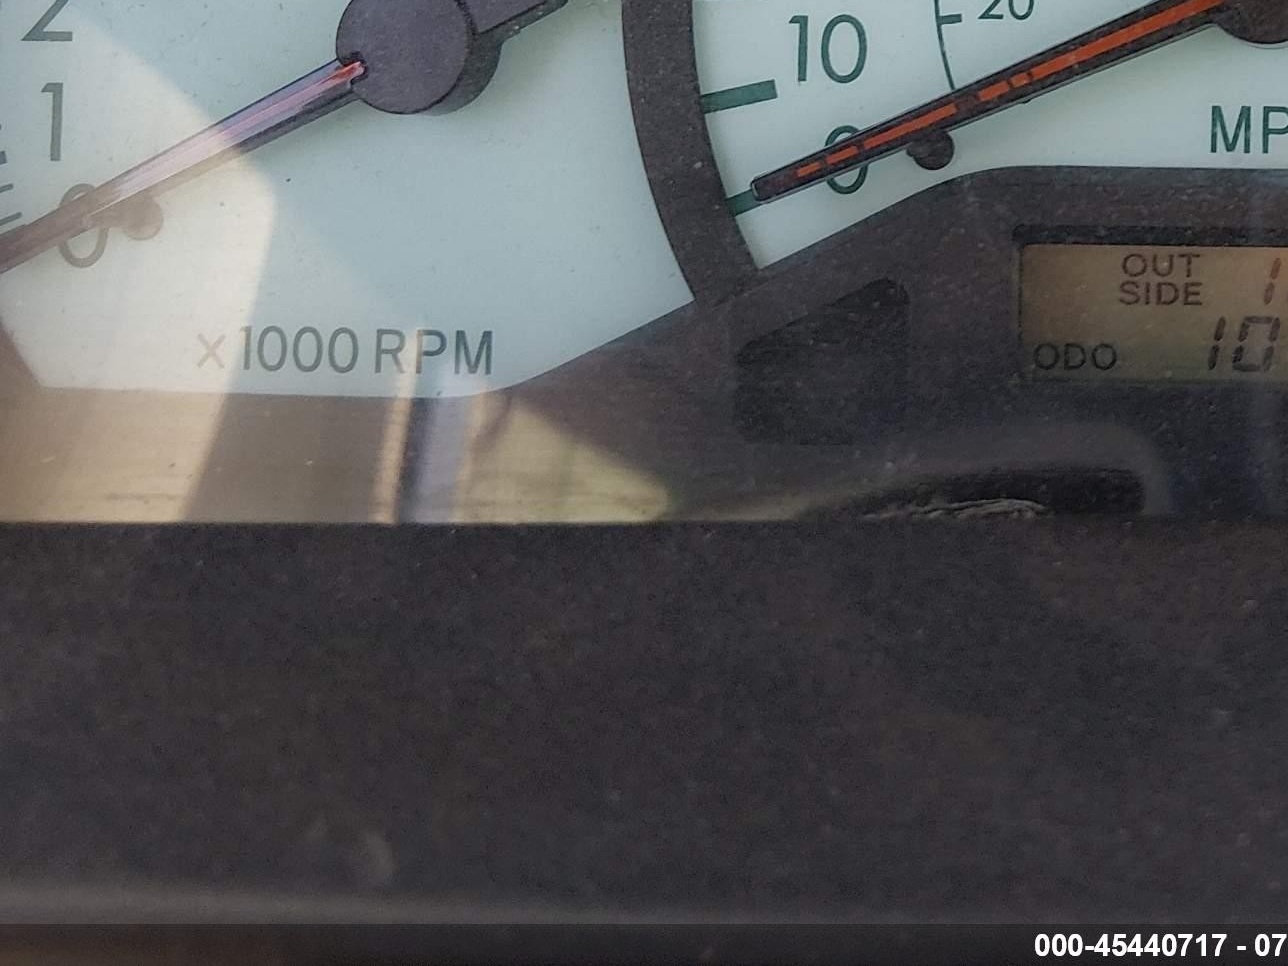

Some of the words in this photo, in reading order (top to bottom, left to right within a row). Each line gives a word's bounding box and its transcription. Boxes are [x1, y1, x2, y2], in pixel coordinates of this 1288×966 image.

[789, 14, 867, 84] 10
[40, 82, 64, 161] 1
[1122, 254, 1201, 278] OUT
[1119, 282, 1203, 307] SIDE
[374, 330, 494, 375] RPM
[1033, 343, 1117, 371] ODO
